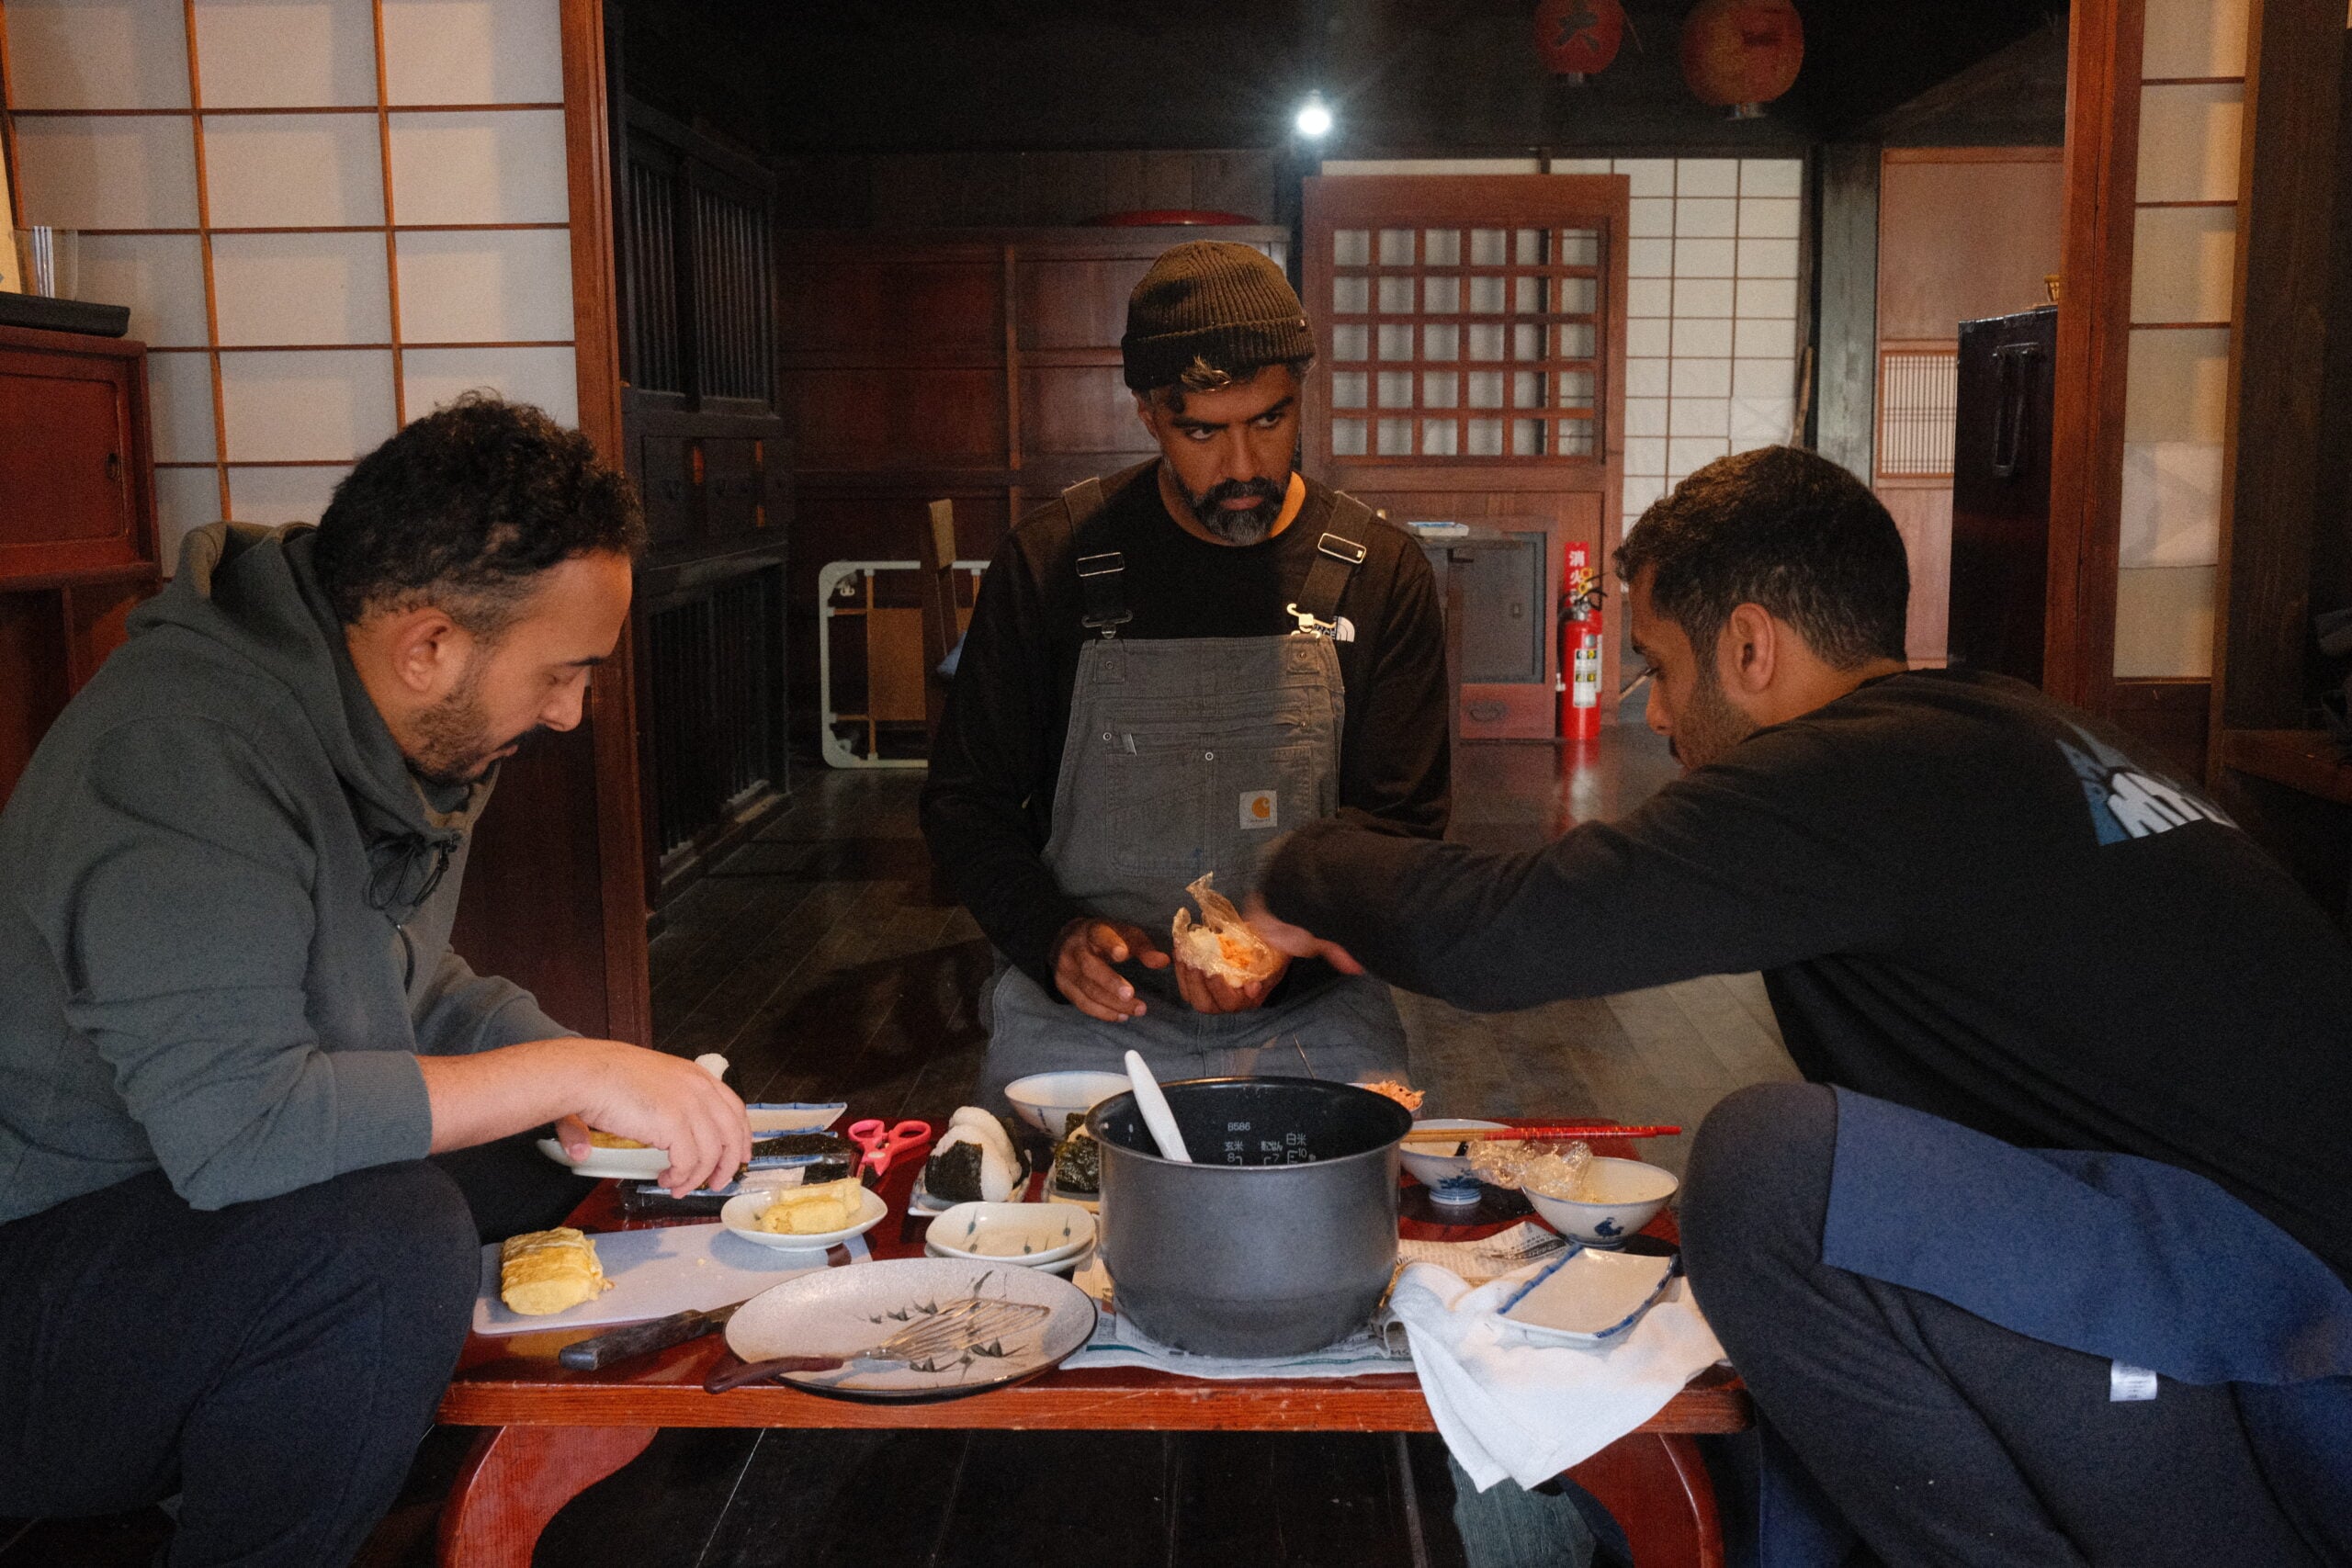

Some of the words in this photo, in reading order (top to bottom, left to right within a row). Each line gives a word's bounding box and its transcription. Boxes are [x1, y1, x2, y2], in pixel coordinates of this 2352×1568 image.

[1286, 1132, 1306, 1145] 白米
[1224, 1140, 1244, 1152] 玄米
[1227, 1152, 1235, 1163] 8
[1272, 1153, 1280, 1163] 7
[1298, 1147, 1307, 1158] 10
